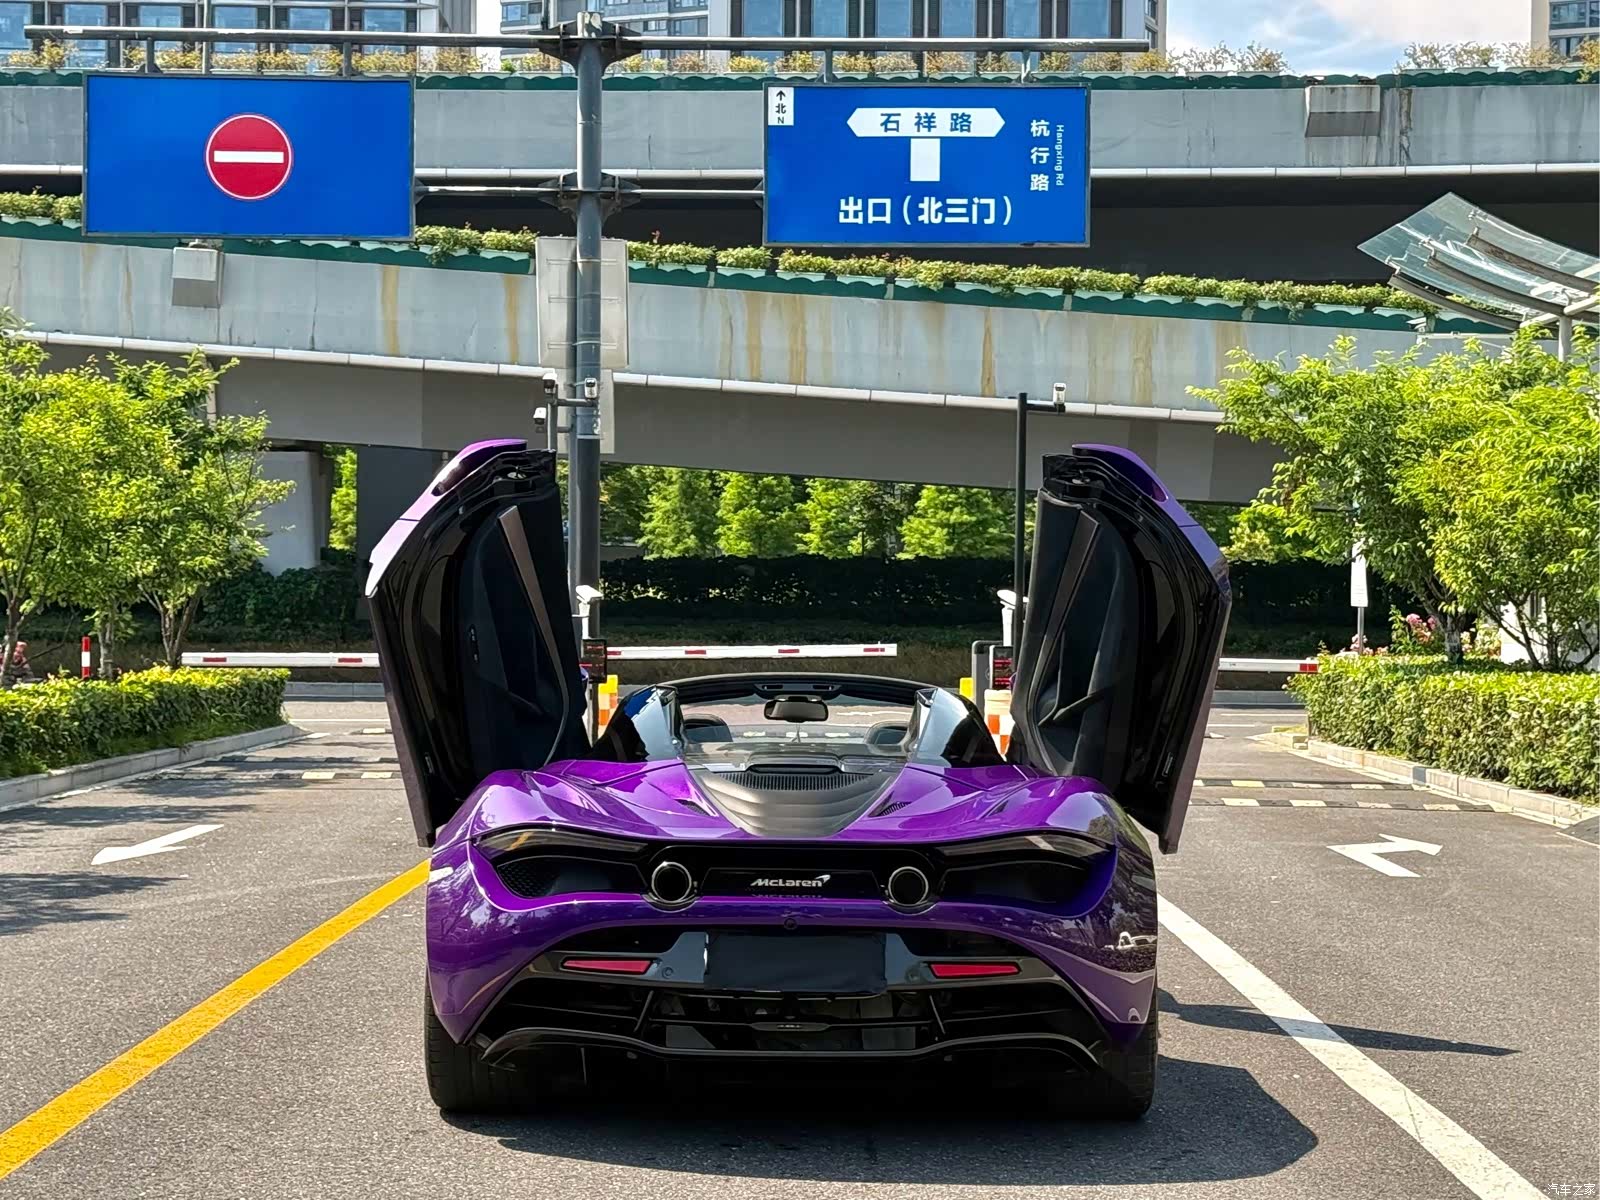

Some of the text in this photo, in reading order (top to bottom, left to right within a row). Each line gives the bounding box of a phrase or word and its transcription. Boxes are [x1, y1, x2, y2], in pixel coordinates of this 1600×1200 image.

[775, 103, 787, 114] 北
[777, 116, 785, 124] N
[880, 112, 972, 133] 石祥路
[1030, 119, 1050, 191] 杭行路
[1054, 124, 1065, 186] Hangxing Rd
[838, 195, 1012, 225] 出口（北三门）
[749, 878, 825, 887] McLaren
